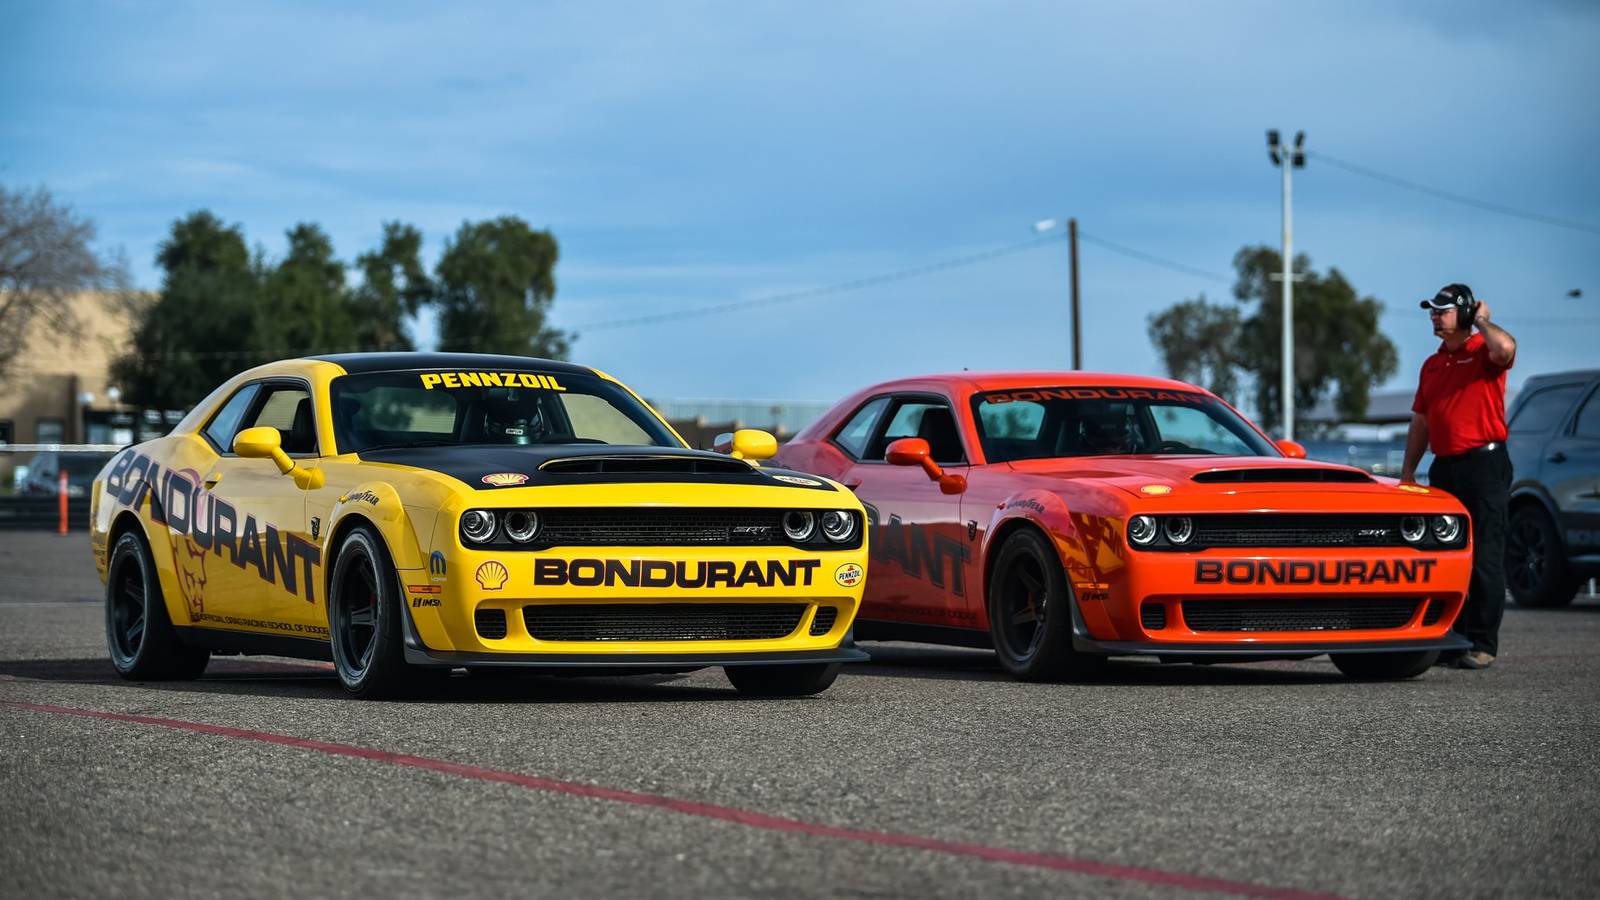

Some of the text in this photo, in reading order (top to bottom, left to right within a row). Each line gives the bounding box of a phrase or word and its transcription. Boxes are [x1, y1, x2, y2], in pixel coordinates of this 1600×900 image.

[420, 372, 567, 391] PENNZOIL
[107, 449, 322, 604] BONDURANT
[733, 526, 771, 535] SRT
[534, 558, 821, 588] BONDURANT
[1194, 558, 1437, 585] BONDURANT
